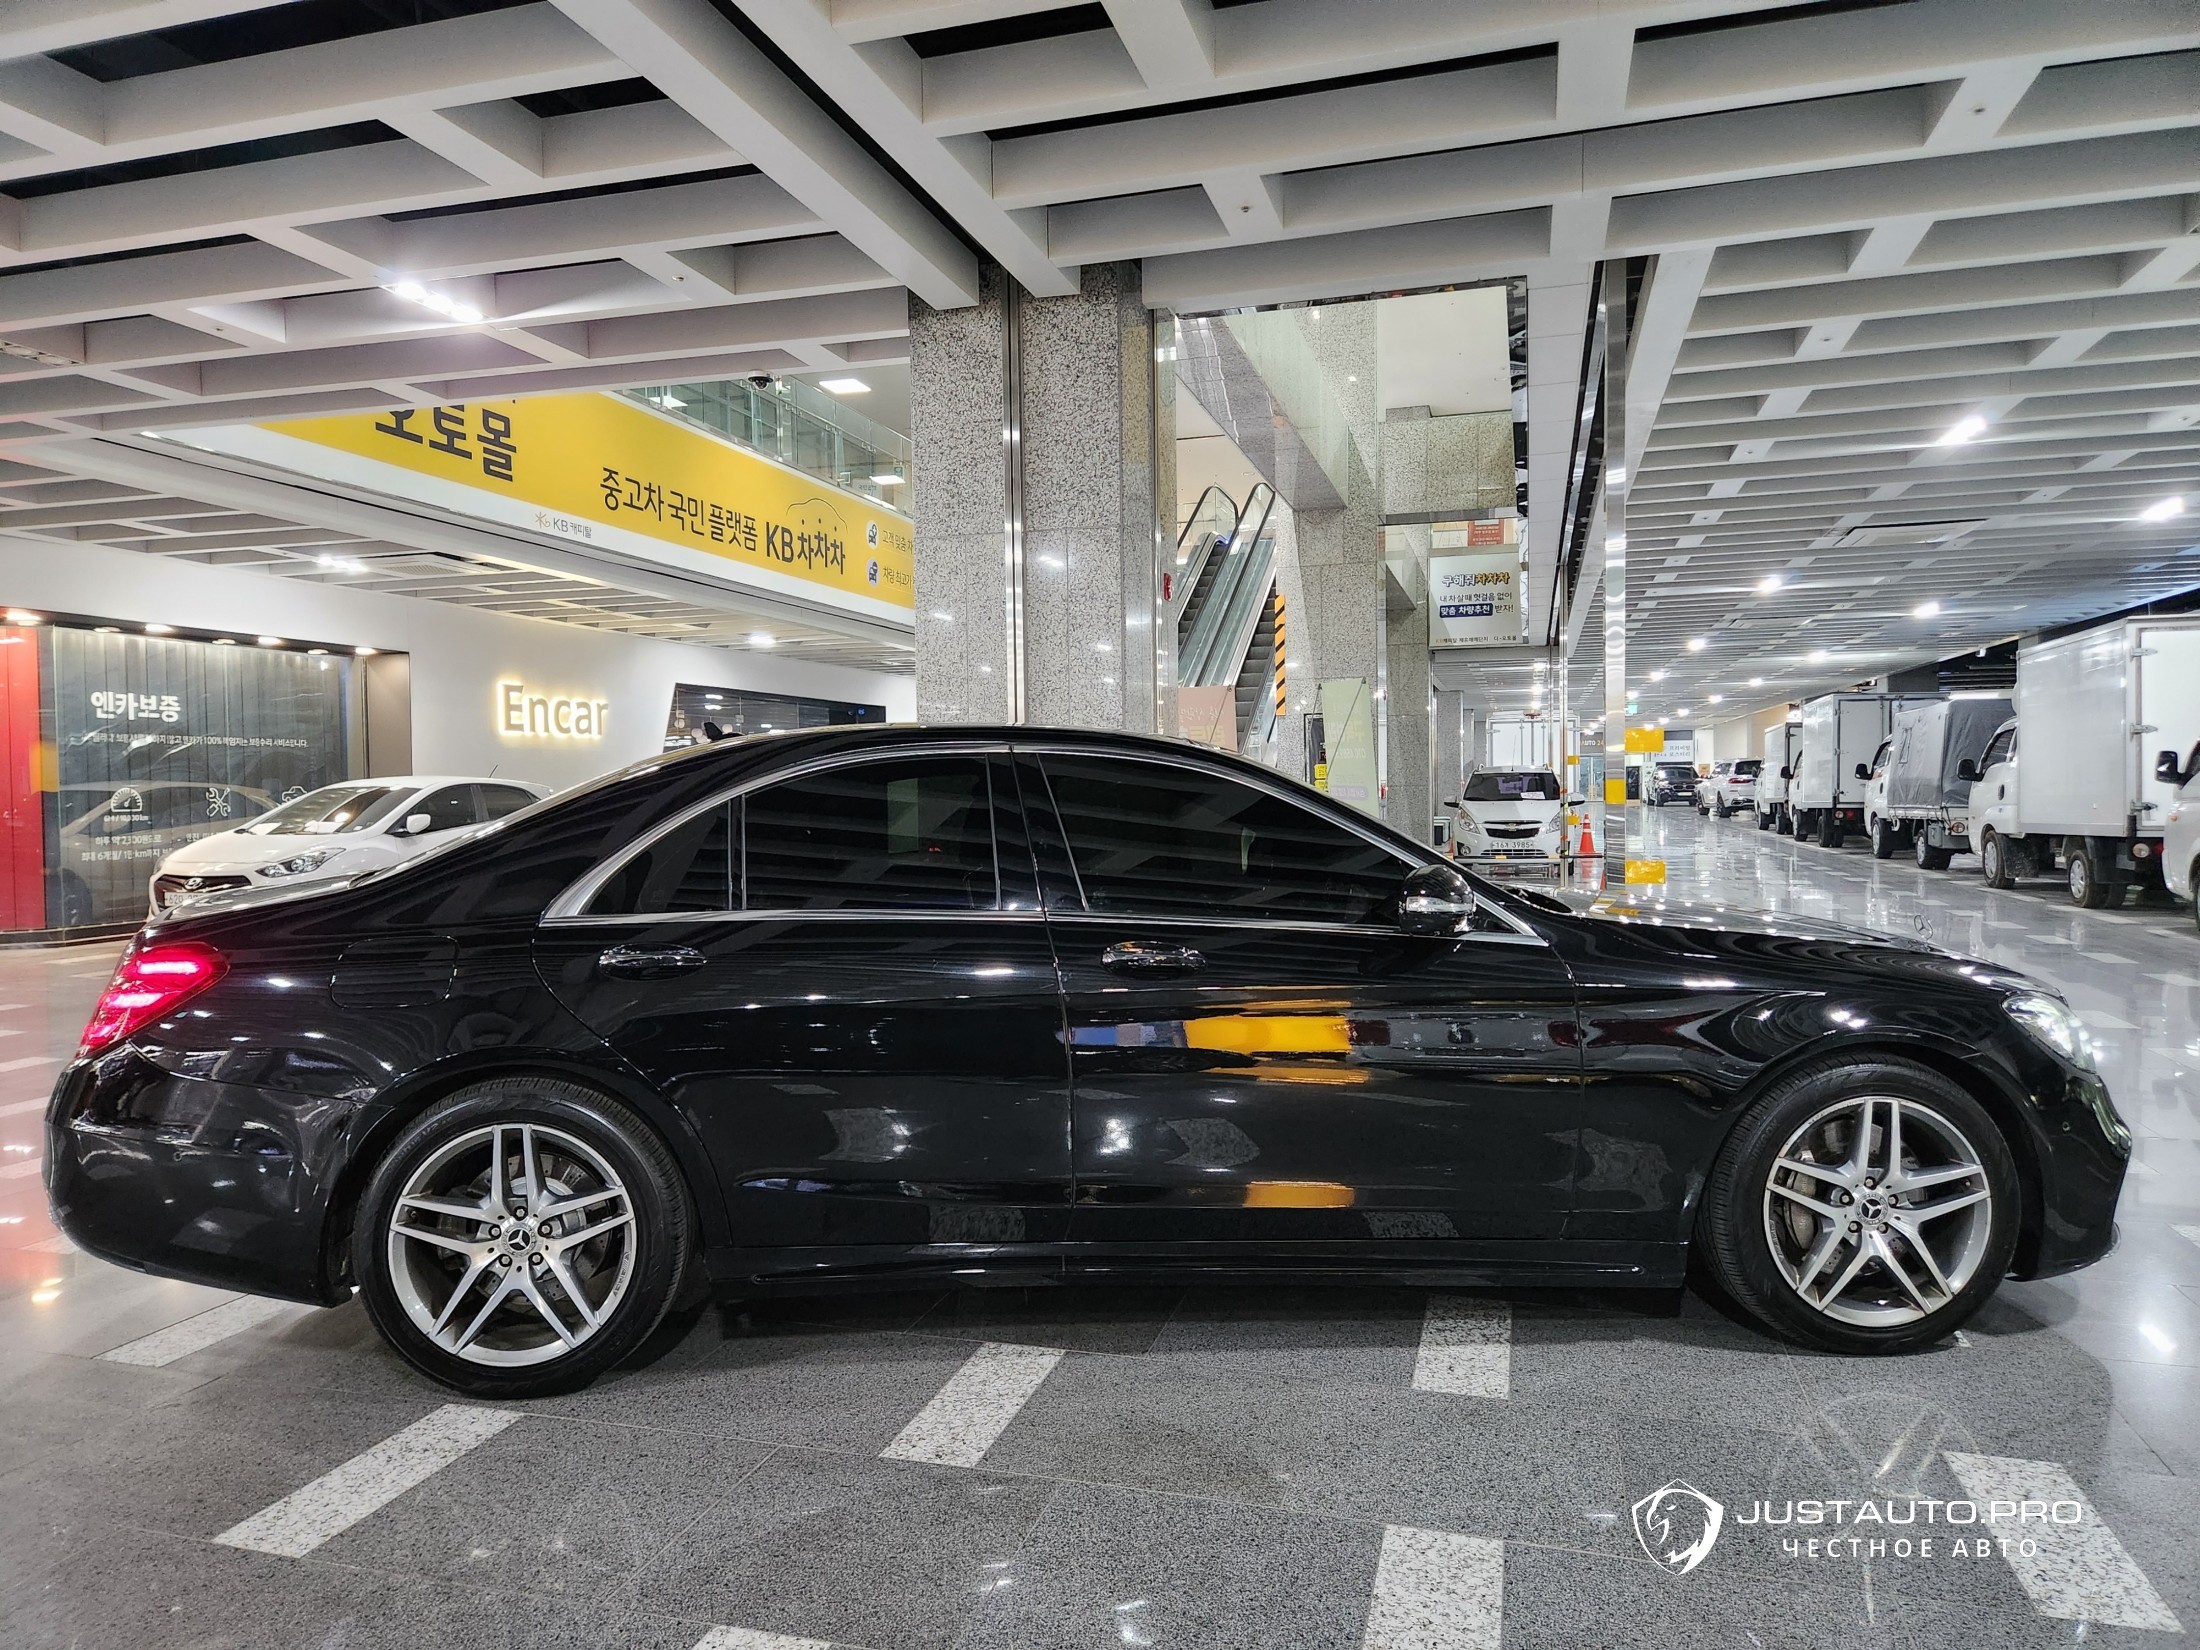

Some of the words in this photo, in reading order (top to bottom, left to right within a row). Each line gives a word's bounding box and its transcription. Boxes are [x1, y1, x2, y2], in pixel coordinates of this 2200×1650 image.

[375, 404, 516, 481] 오토몰
[600, 467, 664, 521] 중고차
[668, 490, 705, 536] 국민
[708, 503, 758, 551] 플랫폼
[1495, 604, 1514, 613] 받자!
[90, 690, 182, 723] 엔카보증
[502, 683, 609, 736] Encar
